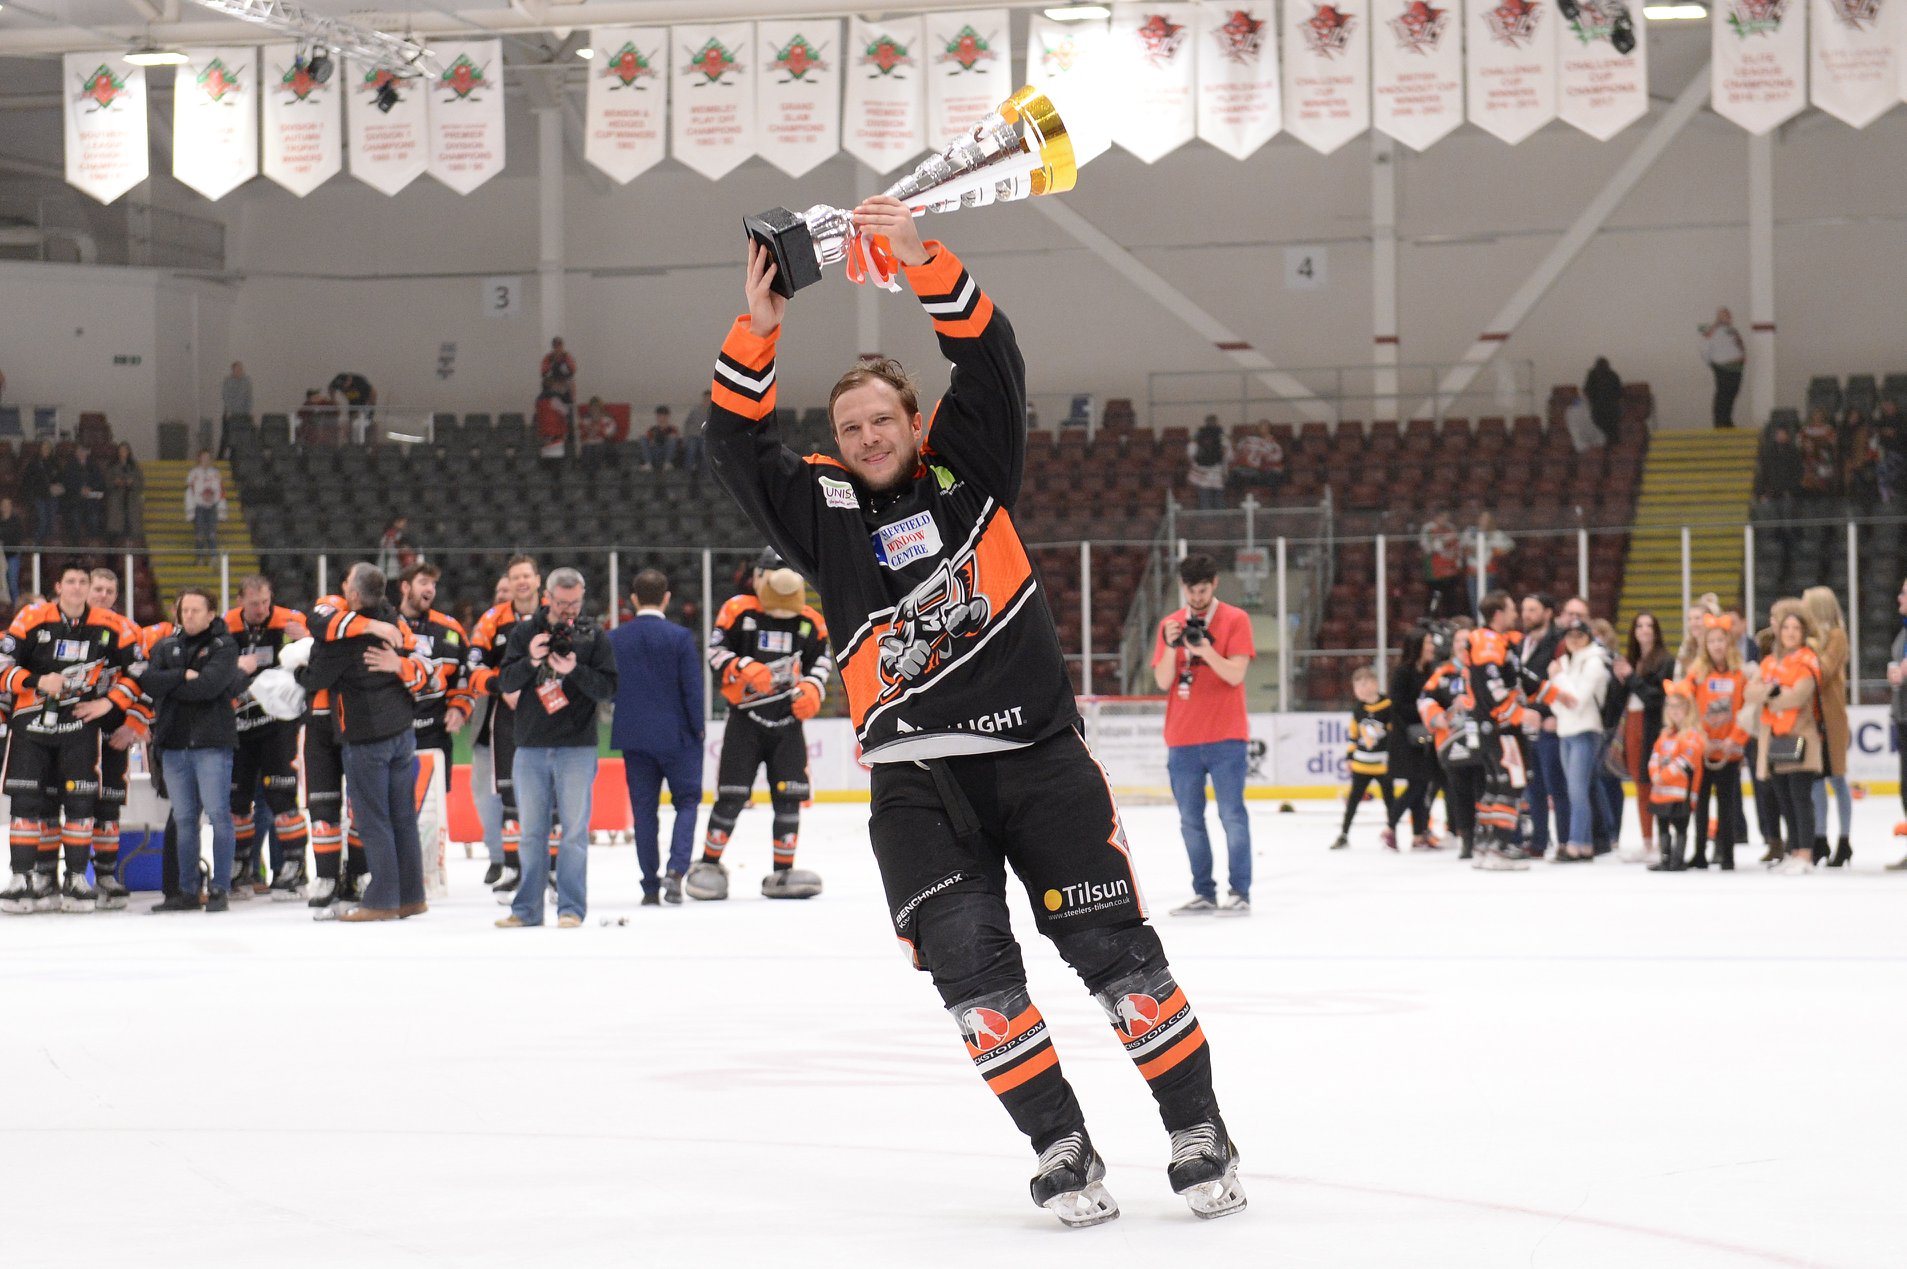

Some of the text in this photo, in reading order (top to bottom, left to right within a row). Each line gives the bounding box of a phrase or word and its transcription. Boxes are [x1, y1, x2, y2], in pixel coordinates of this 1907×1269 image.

[1296, 256, 1313, 280] 4
[494, 285, 510, 310] 3
[891, 543, 929, 568] CENTRE
[896, 873, 963, 924] BENCHMARX
[1062, 879, 1129, 907] Tilsun
[1047, 896, 1131, 921] www.steelers-tilsun.co.uk
